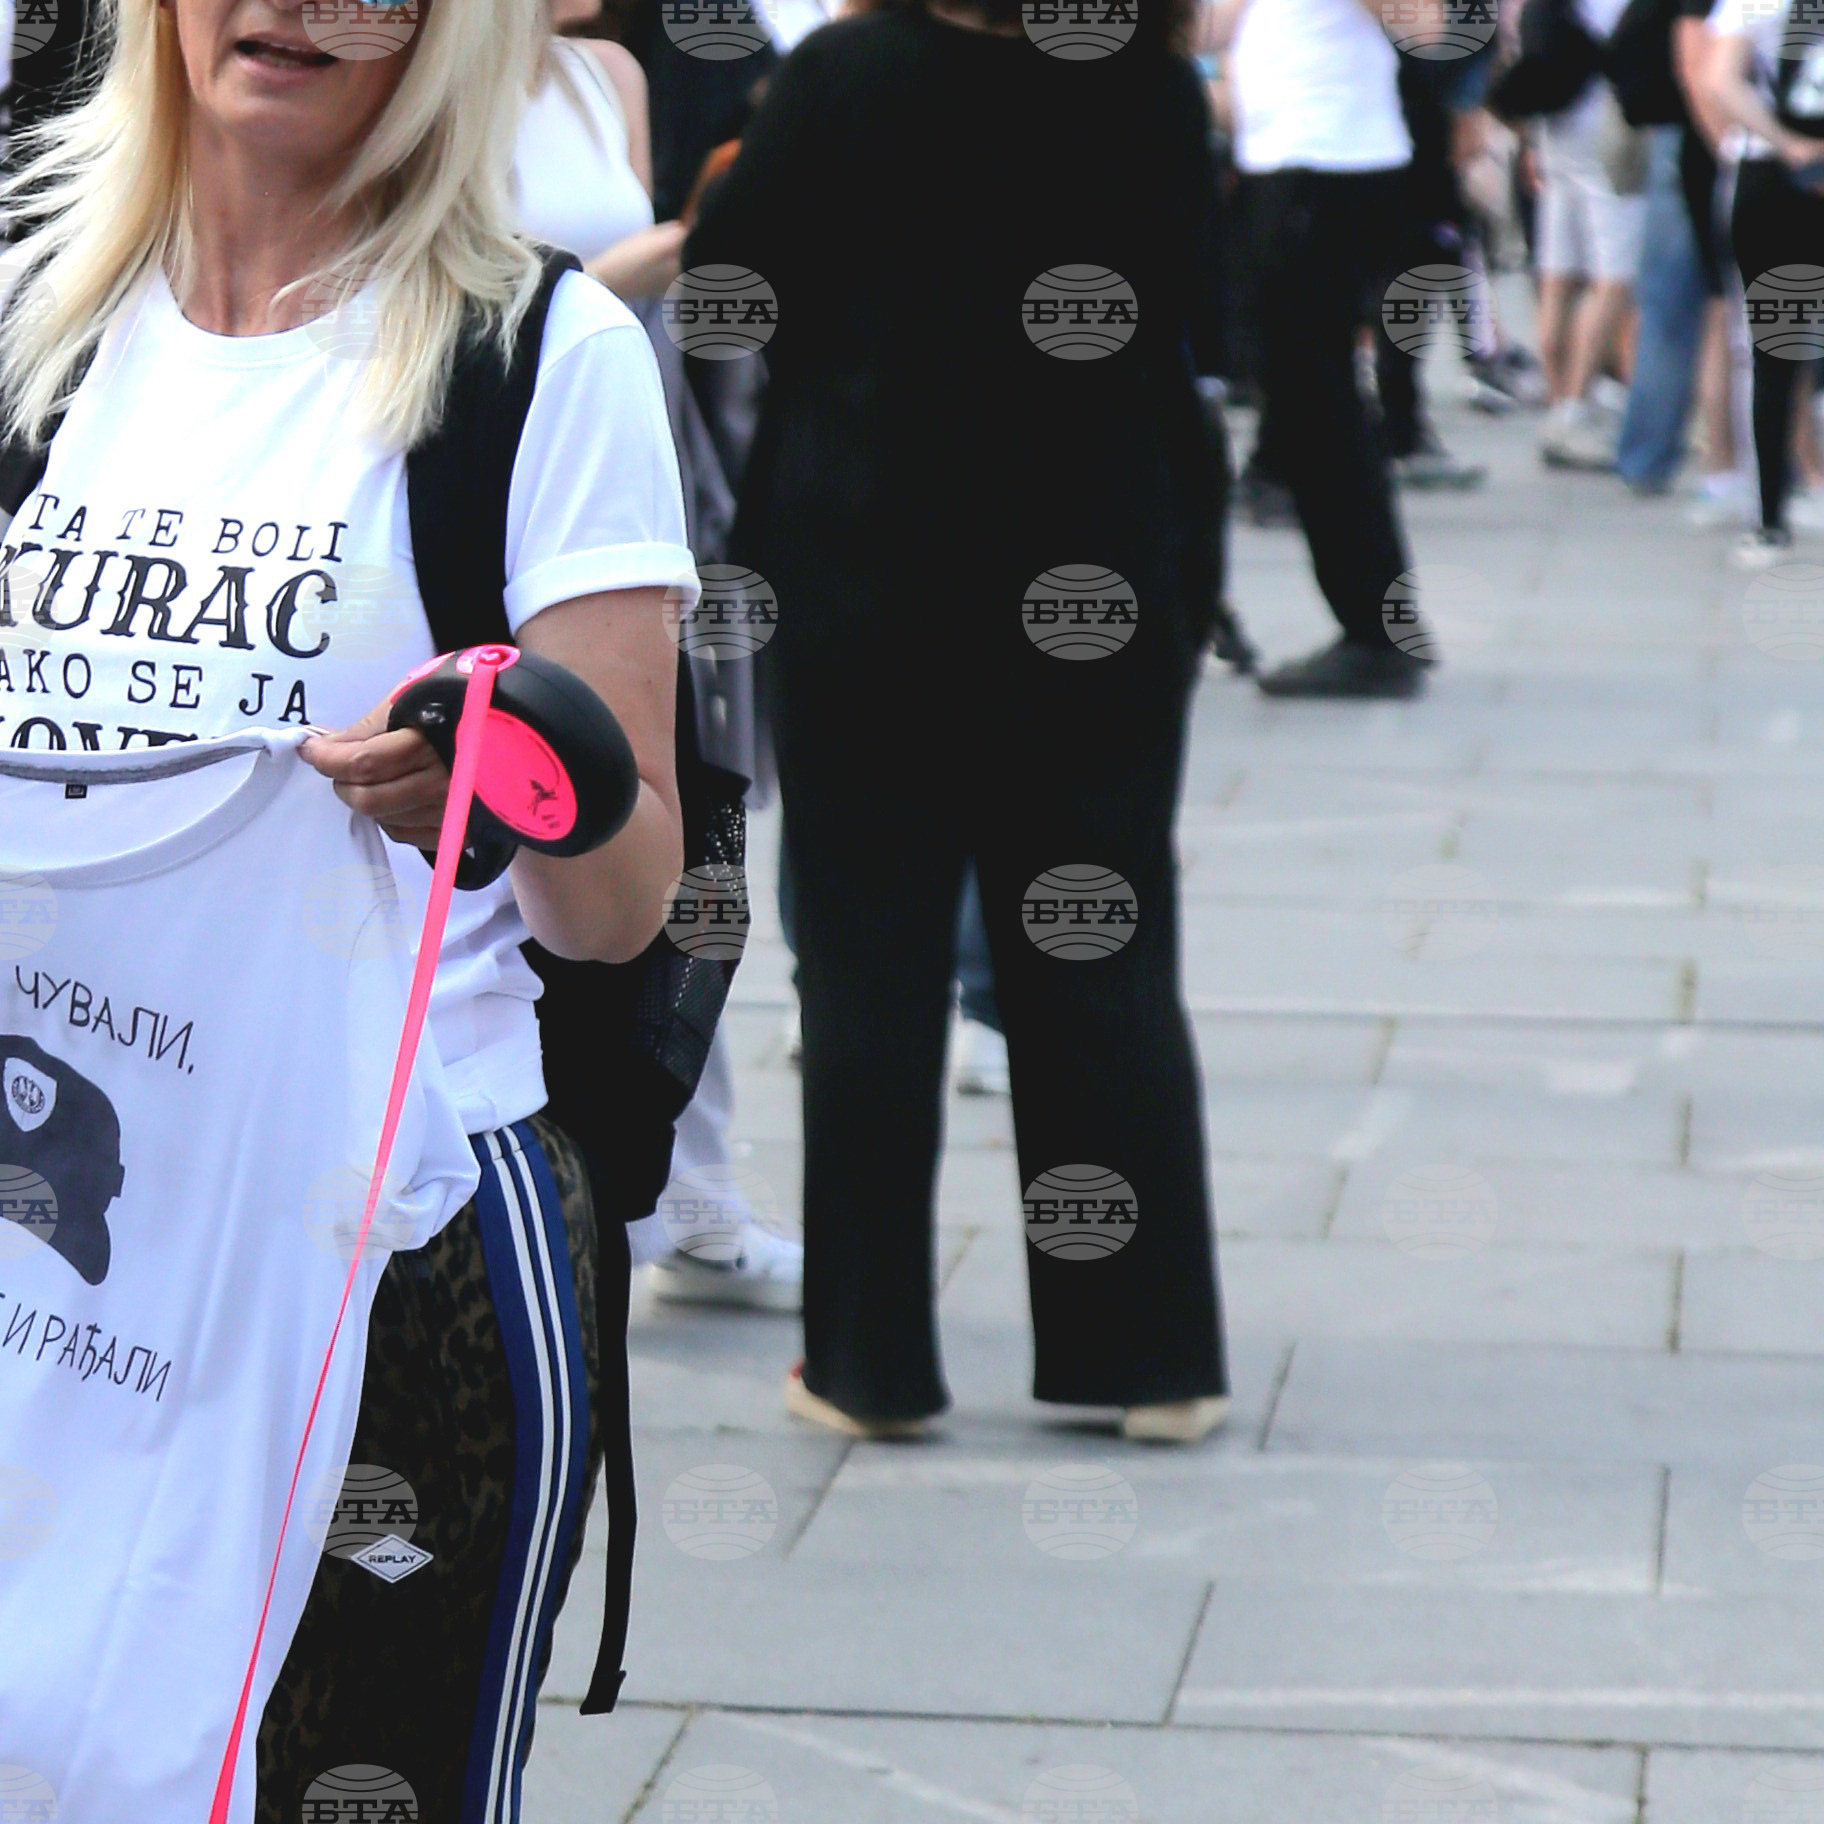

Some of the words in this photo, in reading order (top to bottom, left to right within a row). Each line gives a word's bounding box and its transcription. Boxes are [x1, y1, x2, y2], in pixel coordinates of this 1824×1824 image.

[116, 508, 184, 547] TE
[211, 518, 348, 563] BOLI
[127, 660, 203, 709] SE
[238, 673, 311, 725] JA
[2, 1303, 37, 1354] И
[36, 1314, 171, 1402] РАЂАЛИ
[368, 1554, 416, 1564] REPLAY
